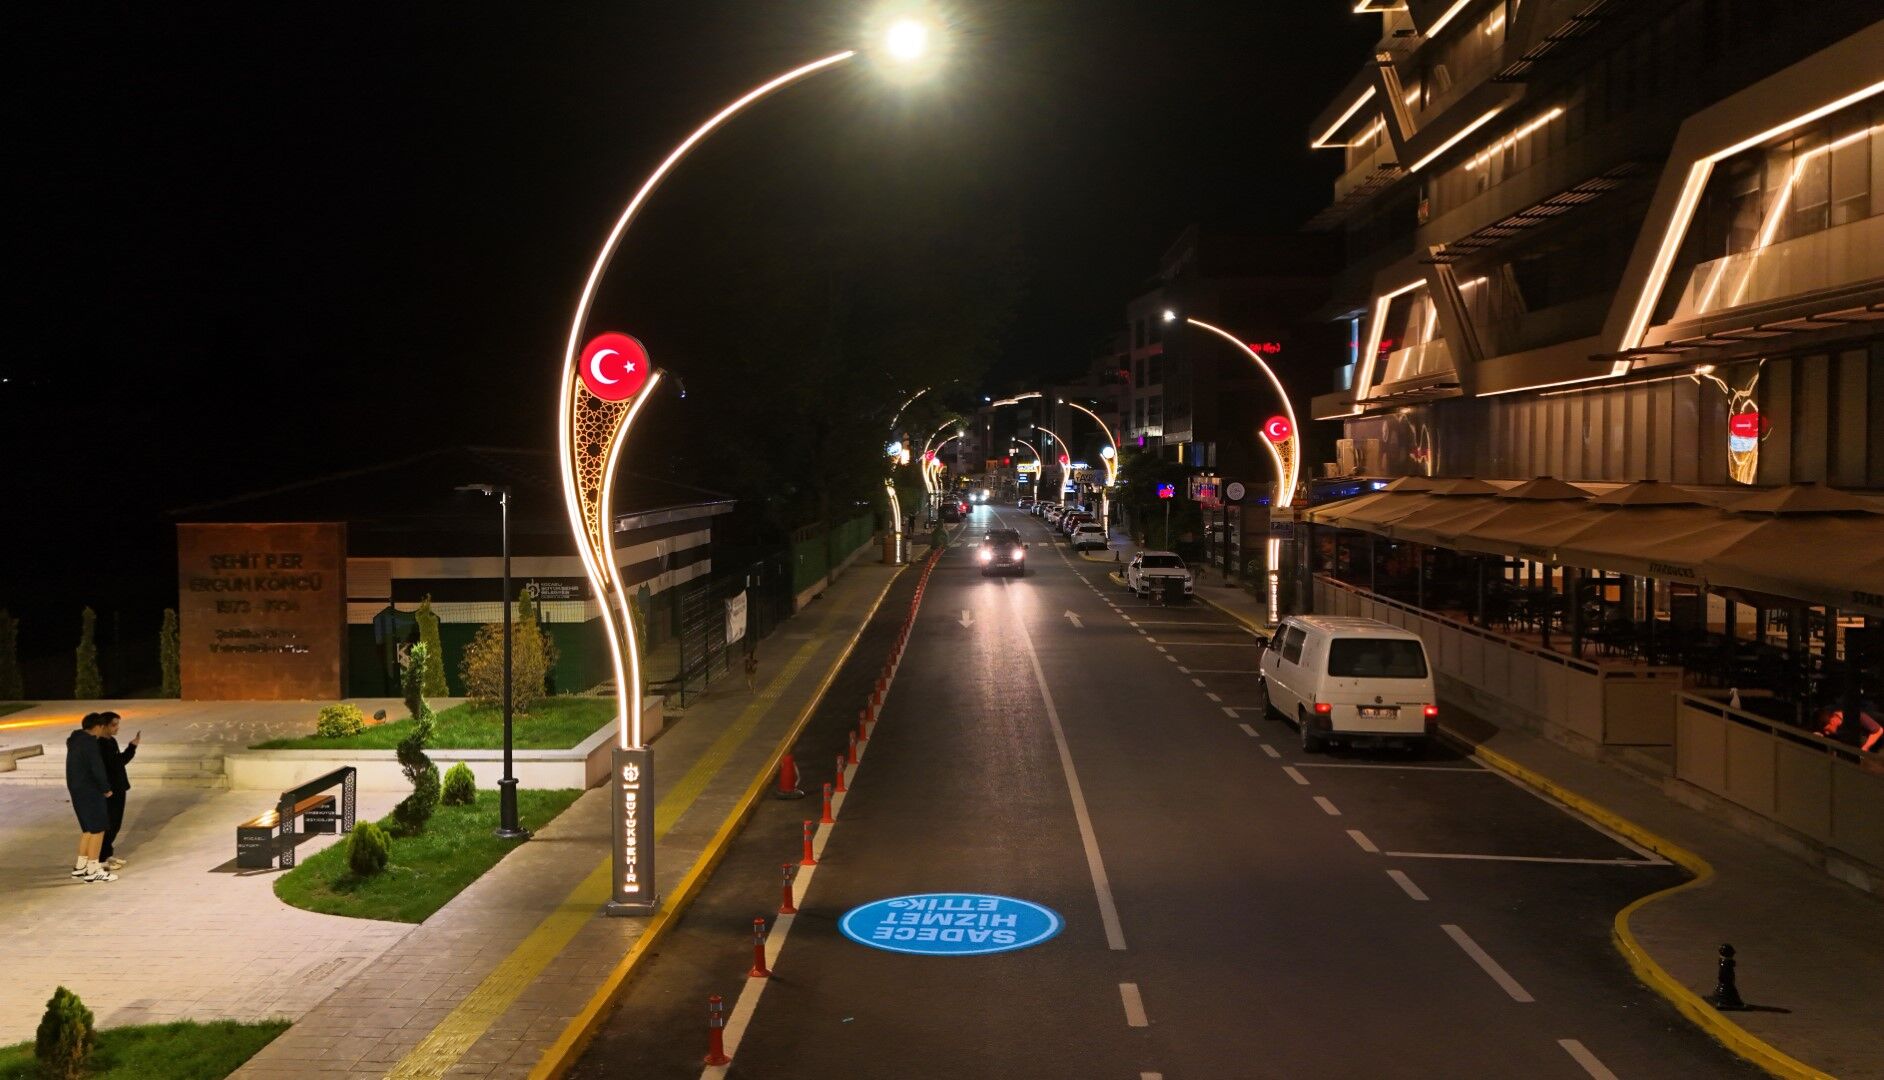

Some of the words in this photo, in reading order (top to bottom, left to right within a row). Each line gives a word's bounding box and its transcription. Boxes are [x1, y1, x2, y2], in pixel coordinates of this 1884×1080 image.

[905, 899, 999, 912] ETTİK
[880, 912, 1018, 928] HİZMET
[873, 926, 1017, 943] SADECE
